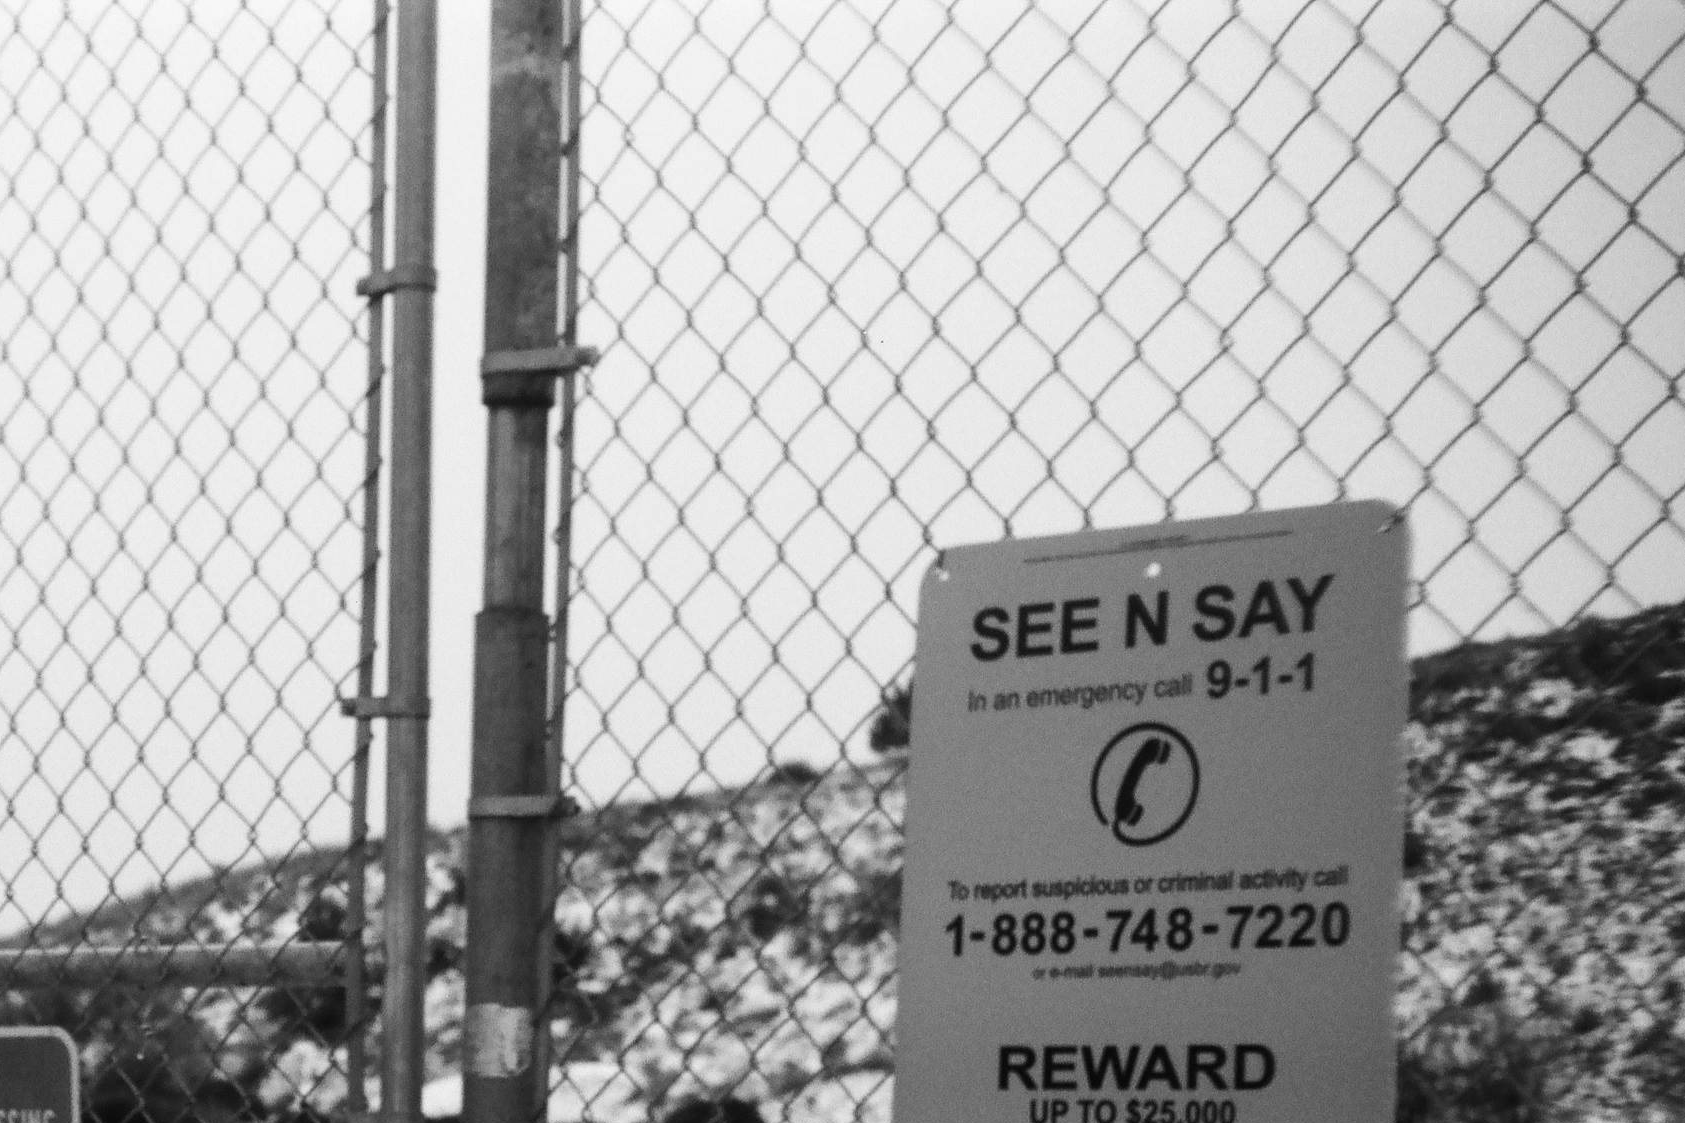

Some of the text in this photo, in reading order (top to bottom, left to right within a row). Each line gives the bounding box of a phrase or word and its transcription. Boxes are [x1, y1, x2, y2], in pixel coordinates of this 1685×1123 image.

[969, 573, 1335, 661] SEE N SAY
[968, 651, 1315, 712] In an emergency call 9-1-1
[947, 864, 1349, 904] To report suspicious or criminal activity call
[945, 901, 1351, 957] 1-888-748-7220
[997, 1043, 1277, 1092] REWARD
